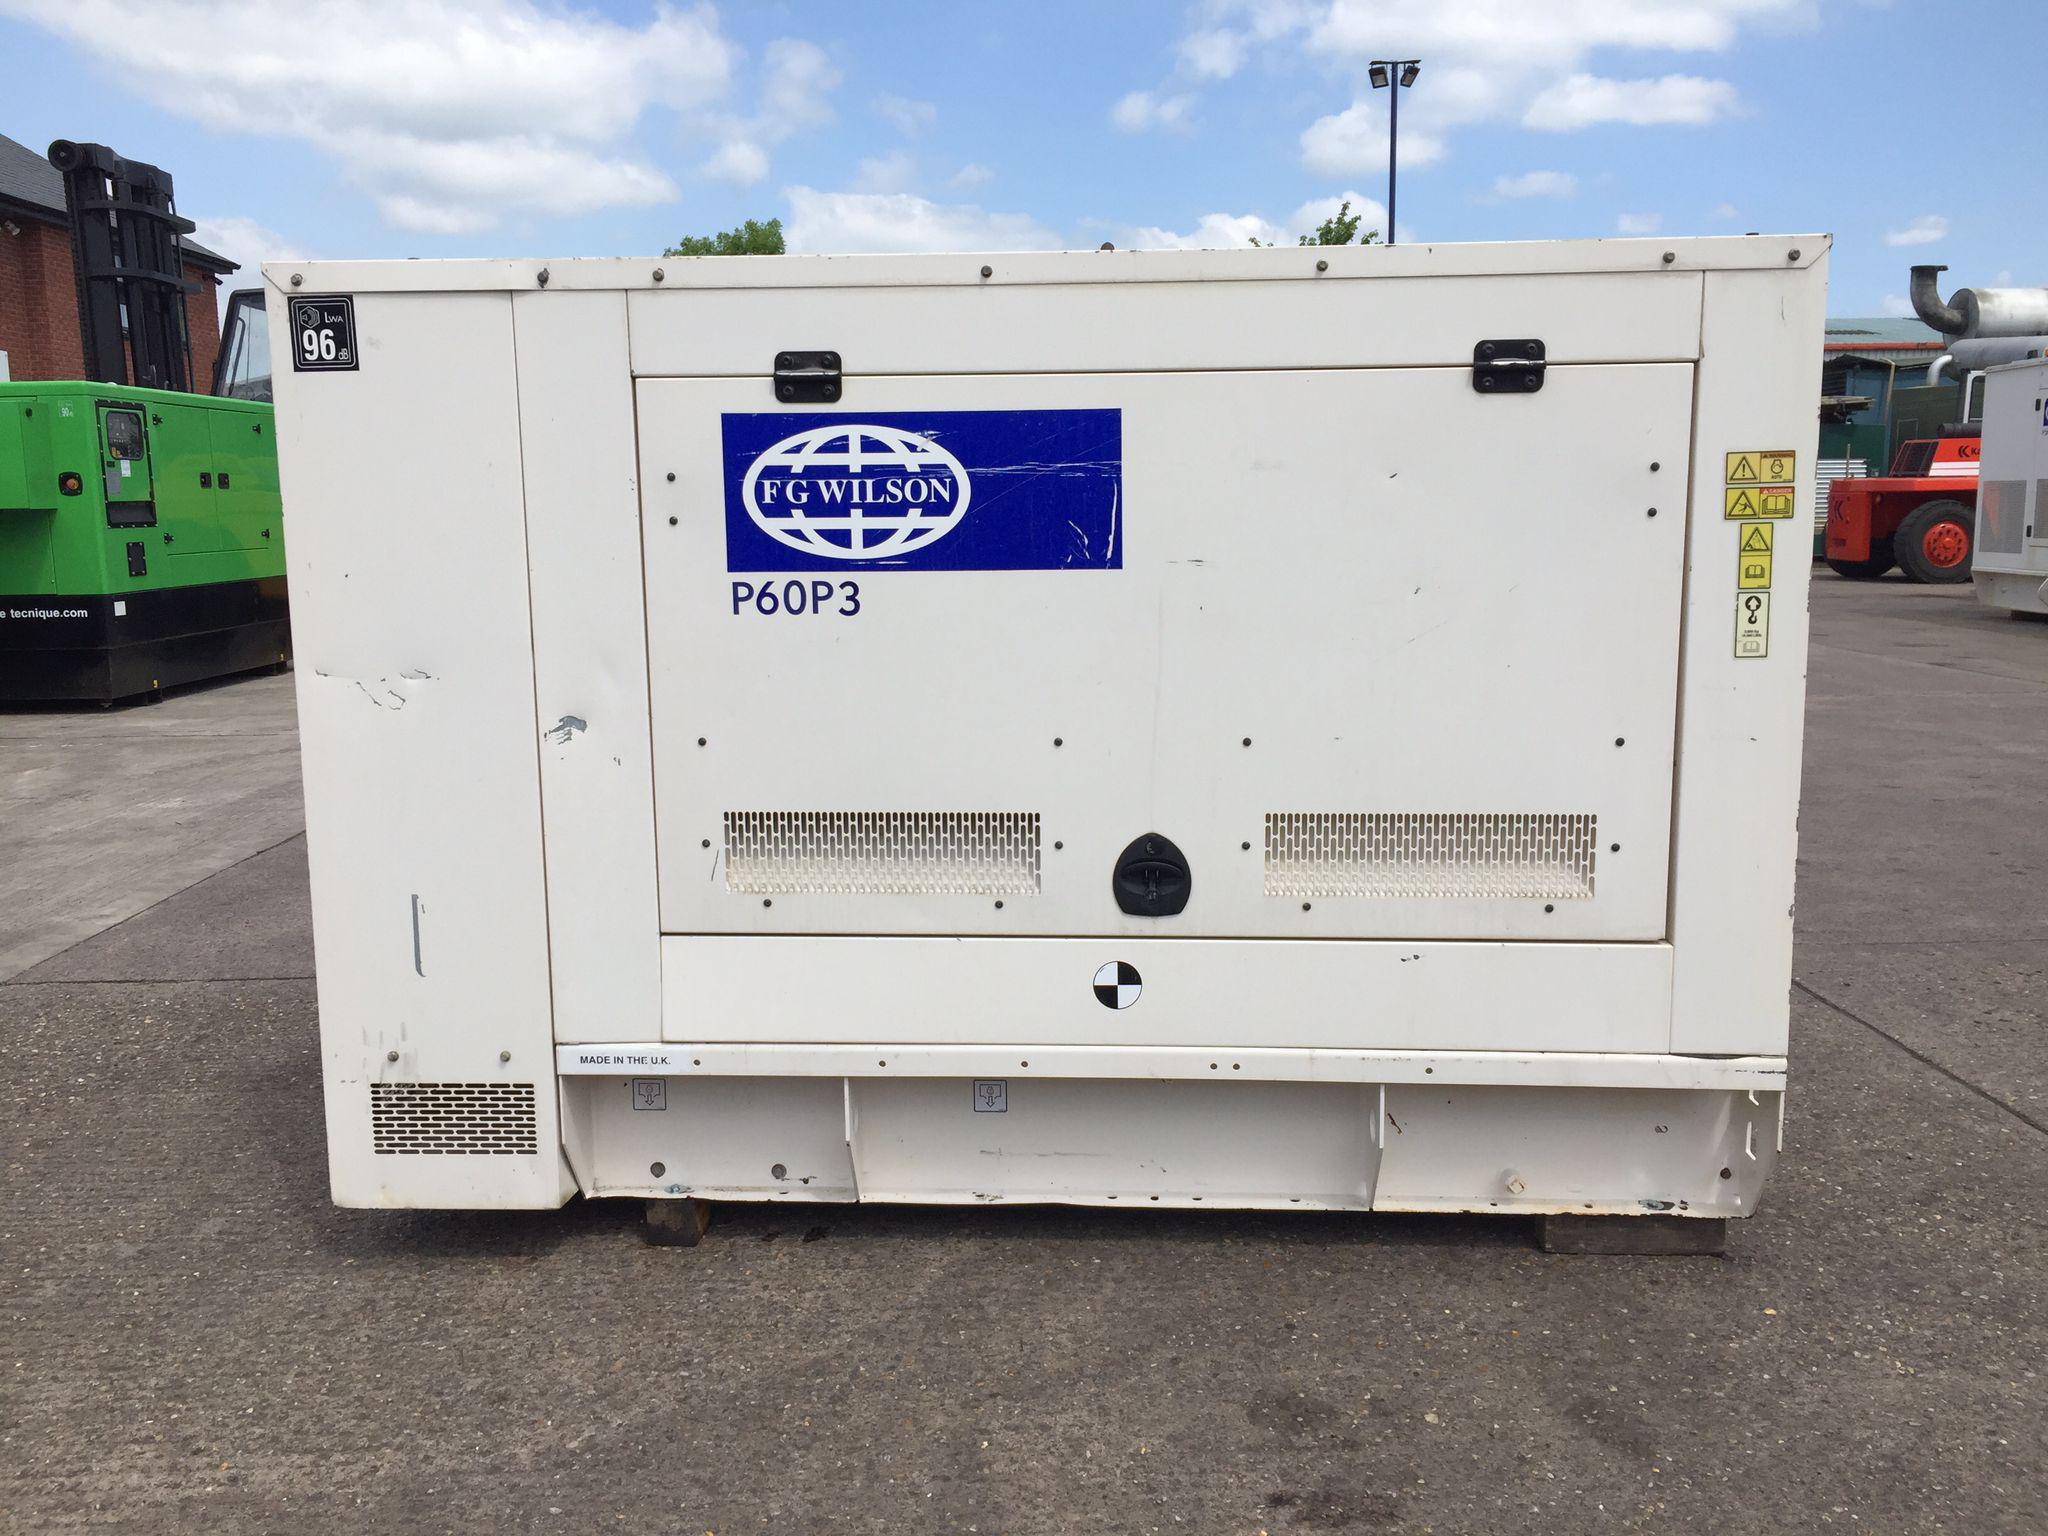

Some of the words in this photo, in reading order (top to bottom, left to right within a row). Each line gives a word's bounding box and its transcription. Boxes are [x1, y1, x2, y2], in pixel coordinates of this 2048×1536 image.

[302, 329, 336, 360] 96
[338, 347, 349, 360] dB
[817, 478, 952, 504] WILSON
[732, 579, 861, 616] P60P3
[10, 607, 88, 620] tecnique.com
[580, 1055, 611, 1065] MADE
[613, 1055, 624, 1065] IN
[626, 1056, 648, 1065] THE
[651, 1056, 671, 1065] U.K.
